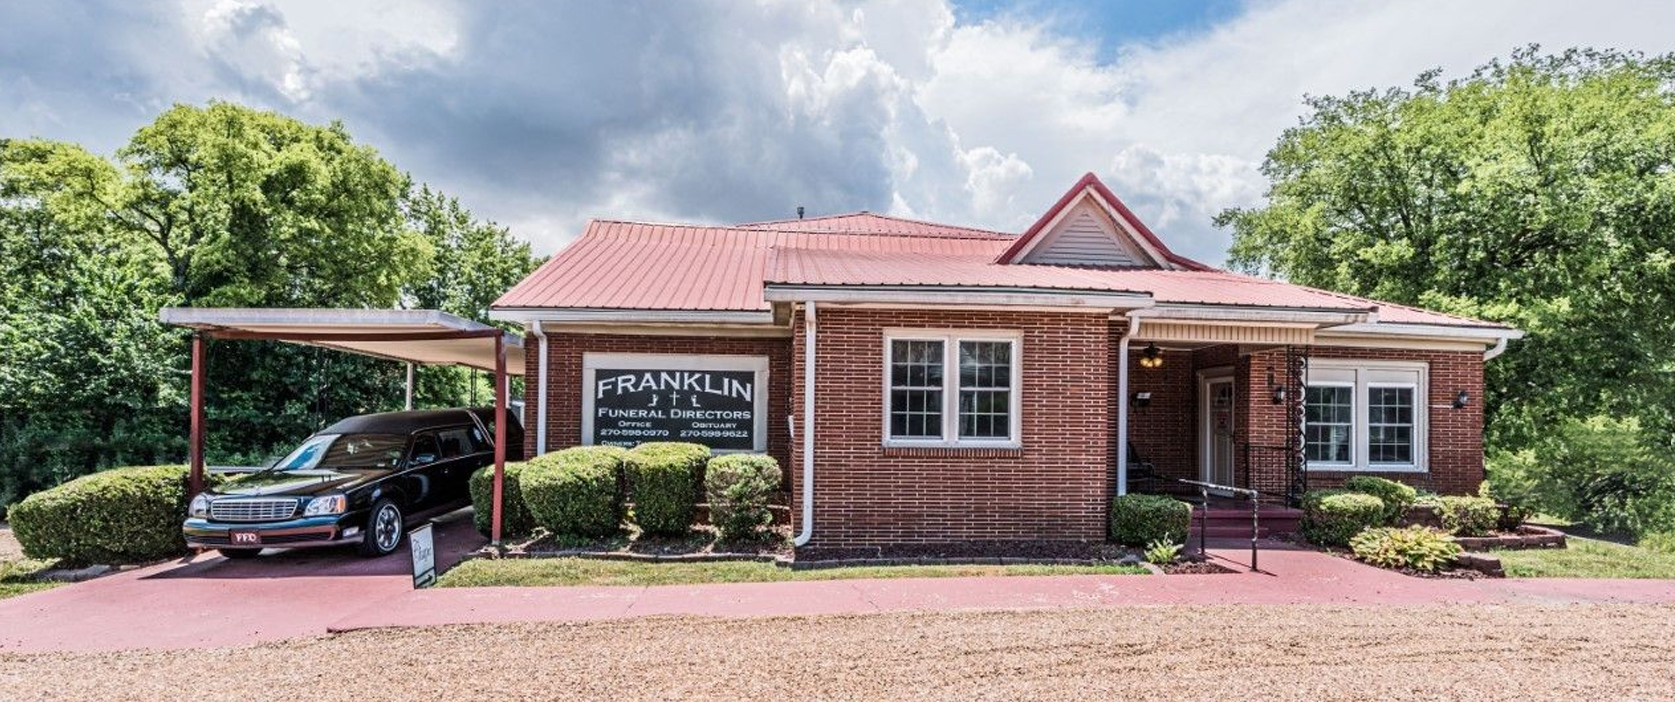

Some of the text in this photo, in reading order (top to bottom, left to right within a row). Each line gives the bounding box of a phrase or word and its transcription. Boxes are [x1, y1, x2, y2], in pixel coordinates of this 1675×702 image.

[597, 371, 752, 402] FRANKLIN
[598, 407, 751, 420] FUNERAL DIRECTORS
[618, 420, 652, 428] OFFICE
[691, 421, 737, 429] OBITUARY
